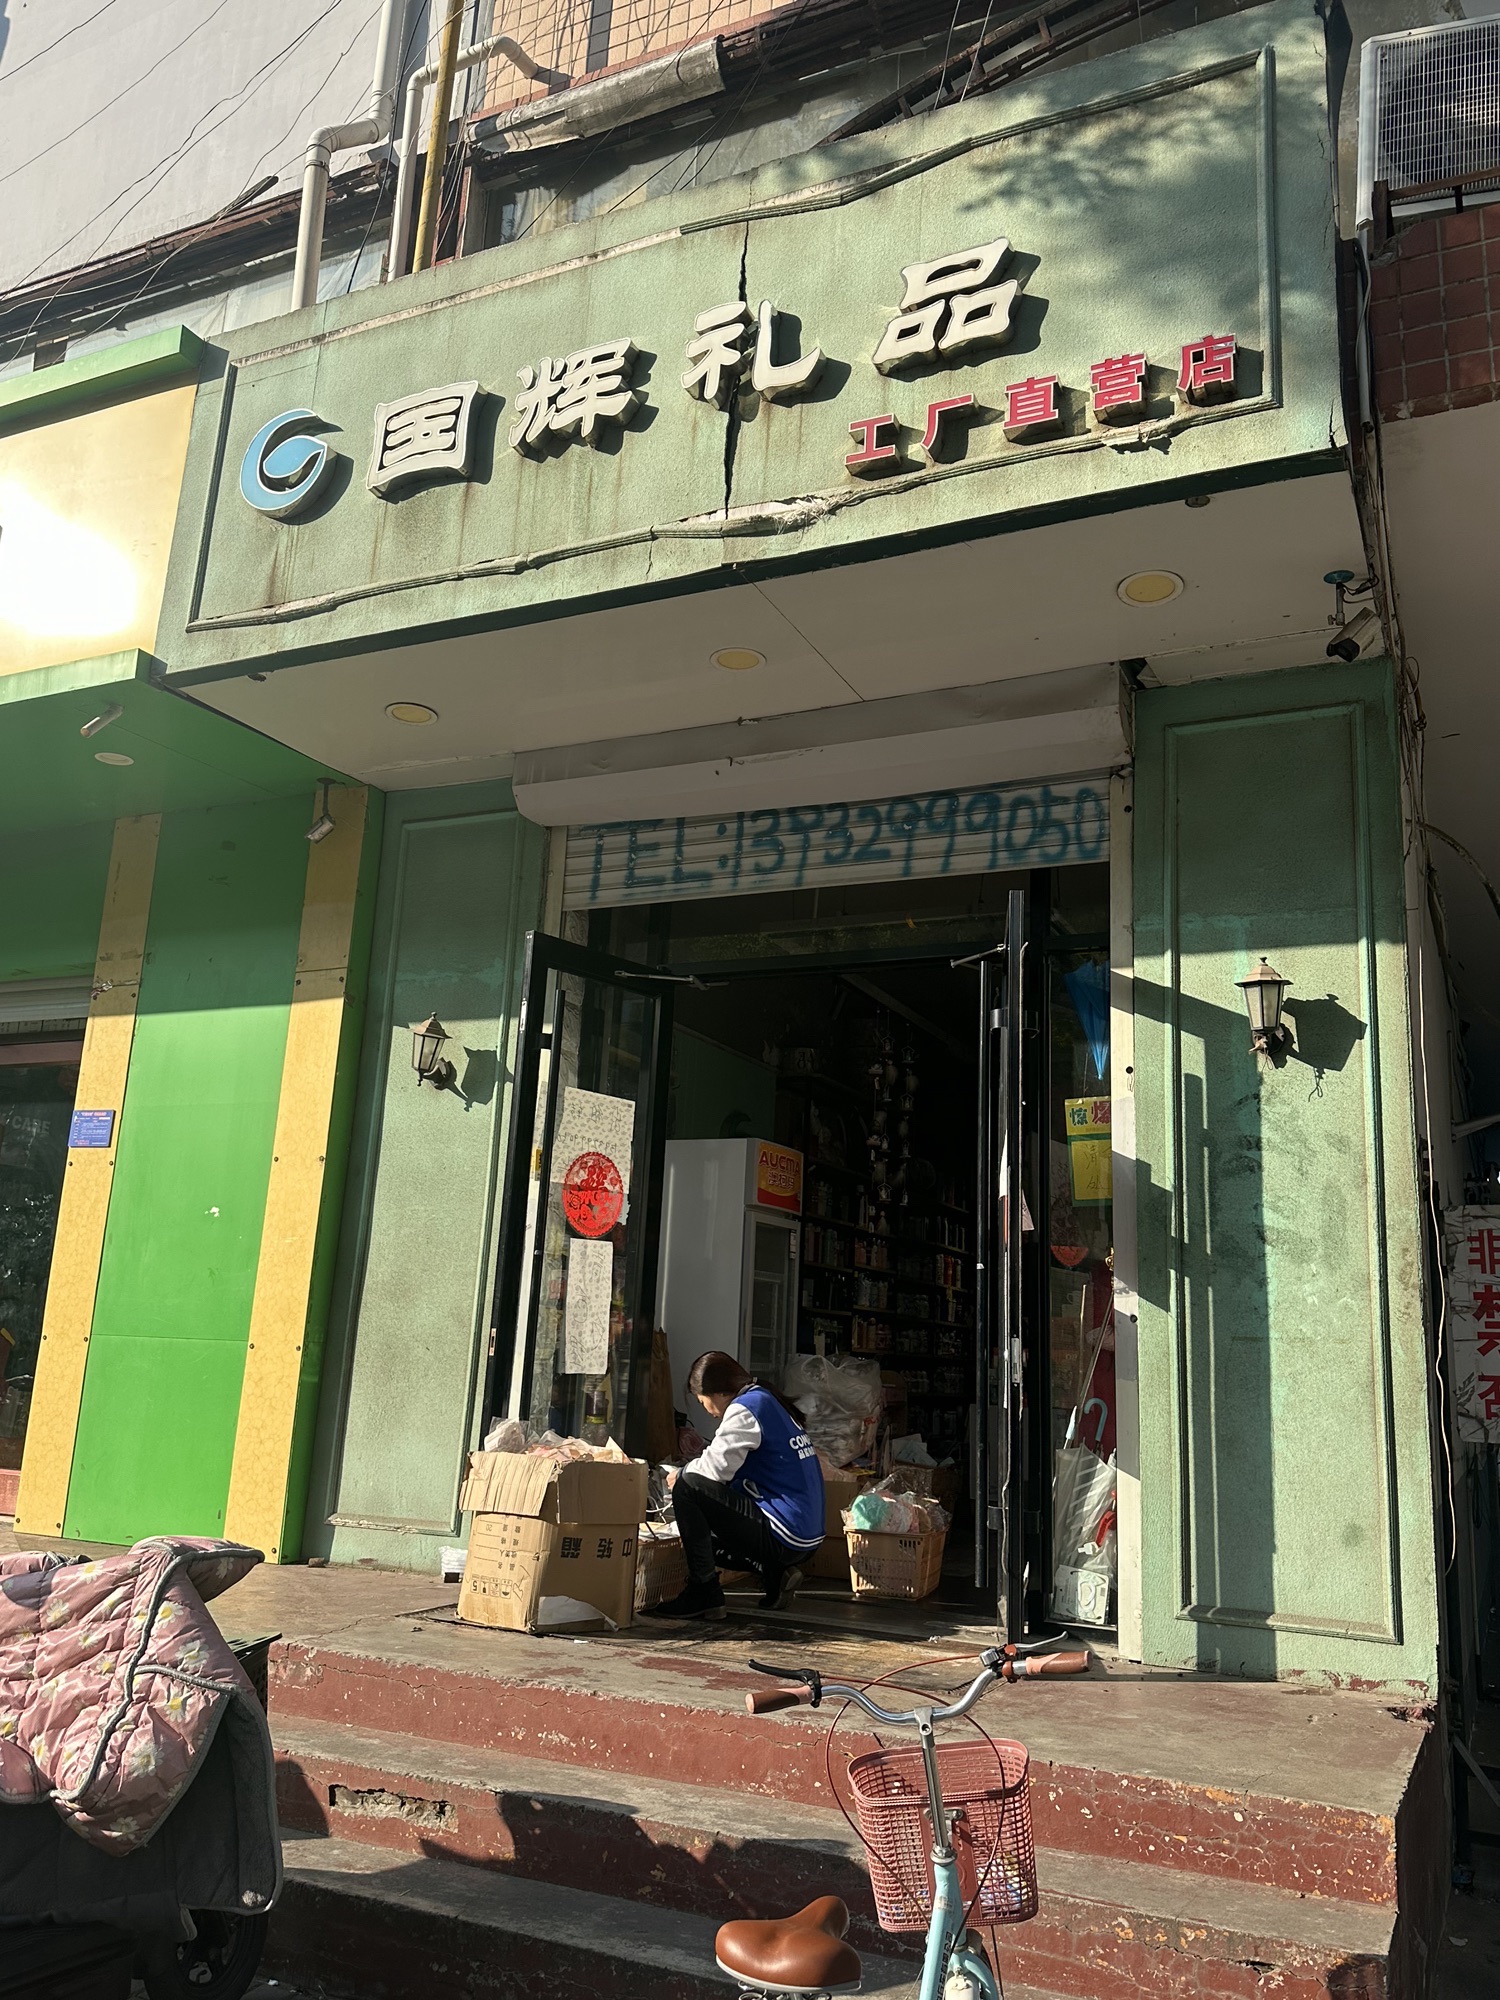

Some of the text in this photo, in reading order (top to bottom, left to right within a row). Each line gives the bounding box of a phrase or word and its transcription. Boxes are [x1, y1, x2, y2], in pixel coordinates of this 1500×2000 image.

[366, 237, 1023, 492] 国辉礼品
[844, 333, 1238, 468] 工厂直营店
[759, 1150, 800, 1175] AUCMA
